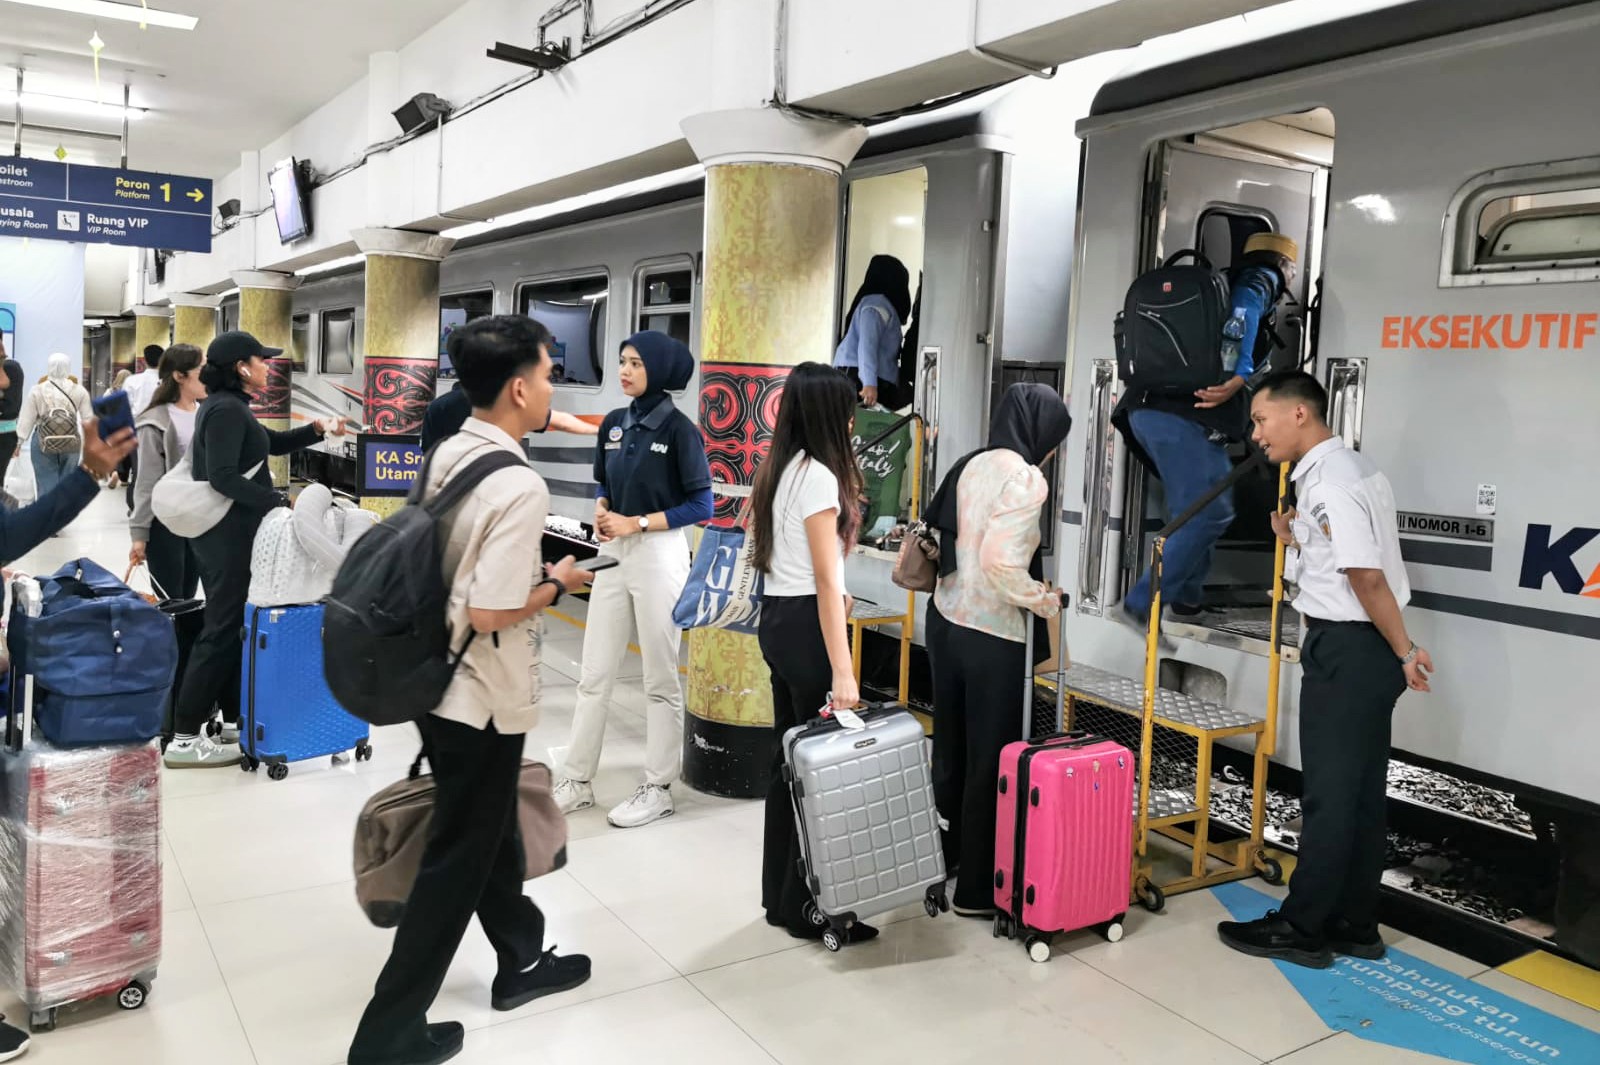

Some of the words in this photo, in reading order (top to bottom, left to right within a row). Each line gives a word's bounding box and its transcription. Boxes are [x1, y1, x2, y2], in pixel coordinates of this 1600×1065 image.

[0, 164, 28, 177] oilet
[0, 178, 34, 187] stroom
[115, 176, 150, 191] Peron
[160, 182, 171, 203] 1
[115, 189, 151, 201] Platform
[0, 206, 34, 218] usala
[0, 218, 21, 229] ying
[23, 219, 49, 230] Room
[87, 213, 126, 228] Ruang
[128, 217, 149, 228] VIP
[87, 226, 102, 234] VIP
[103, 227, 127, 236] Room
[1381, 313, 1598, 349] EKSEKUTIF
[376, 451, 400, 464] KA
[375, 466, 418, 480] Utam
[1407, 516, 1460, 534] NOMOR
[1464, 524, 1487, 536] 1-6
[1332, 953, 1468, 1017] numpang
[1474, 1014, 1561, 1058] turun
[1367, 985, 1446, 1023] alighting
[1443, 1021, 1550, 1065] passenge
